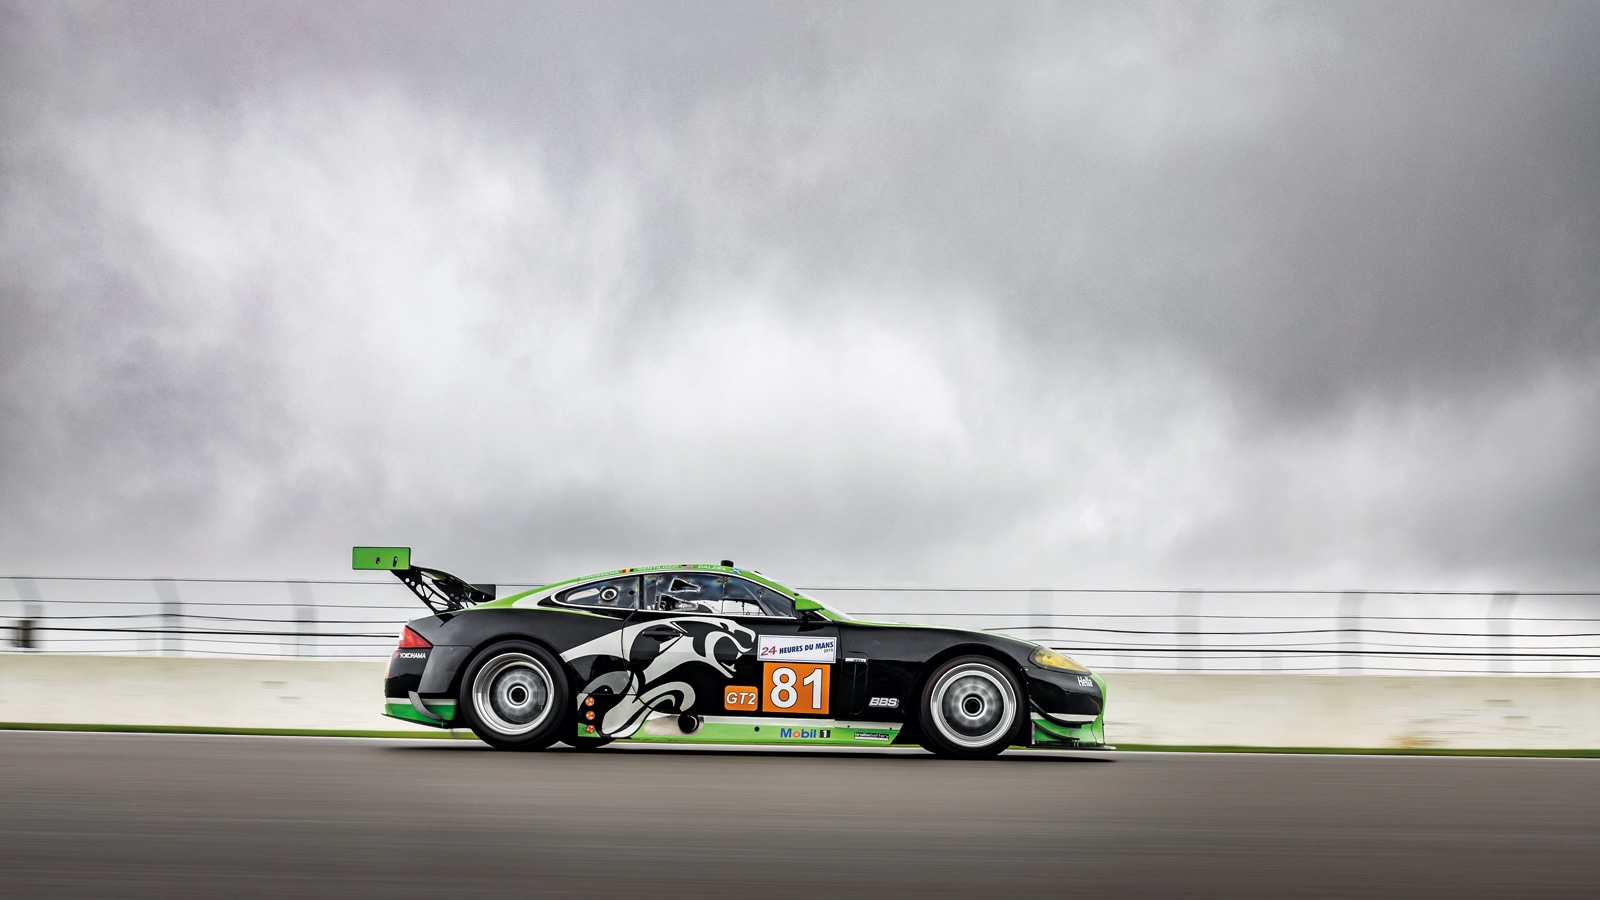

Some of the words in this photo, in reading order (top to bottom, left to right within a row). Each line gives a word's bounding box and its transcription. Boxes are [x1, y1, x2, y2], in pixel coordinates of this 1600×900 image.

[760, 646, 777, 656] 24
[779, 645, 803, 654] HEURES
[815, 641, 834, 649] MANS
[1077, 676, 1093, 687] Hella
[770, 667, 822, 709] 81
[726, 692, 757, 705] GT2
[868, 697, 899, 708] BBS
[780, 728, 816, 738] Mobil
